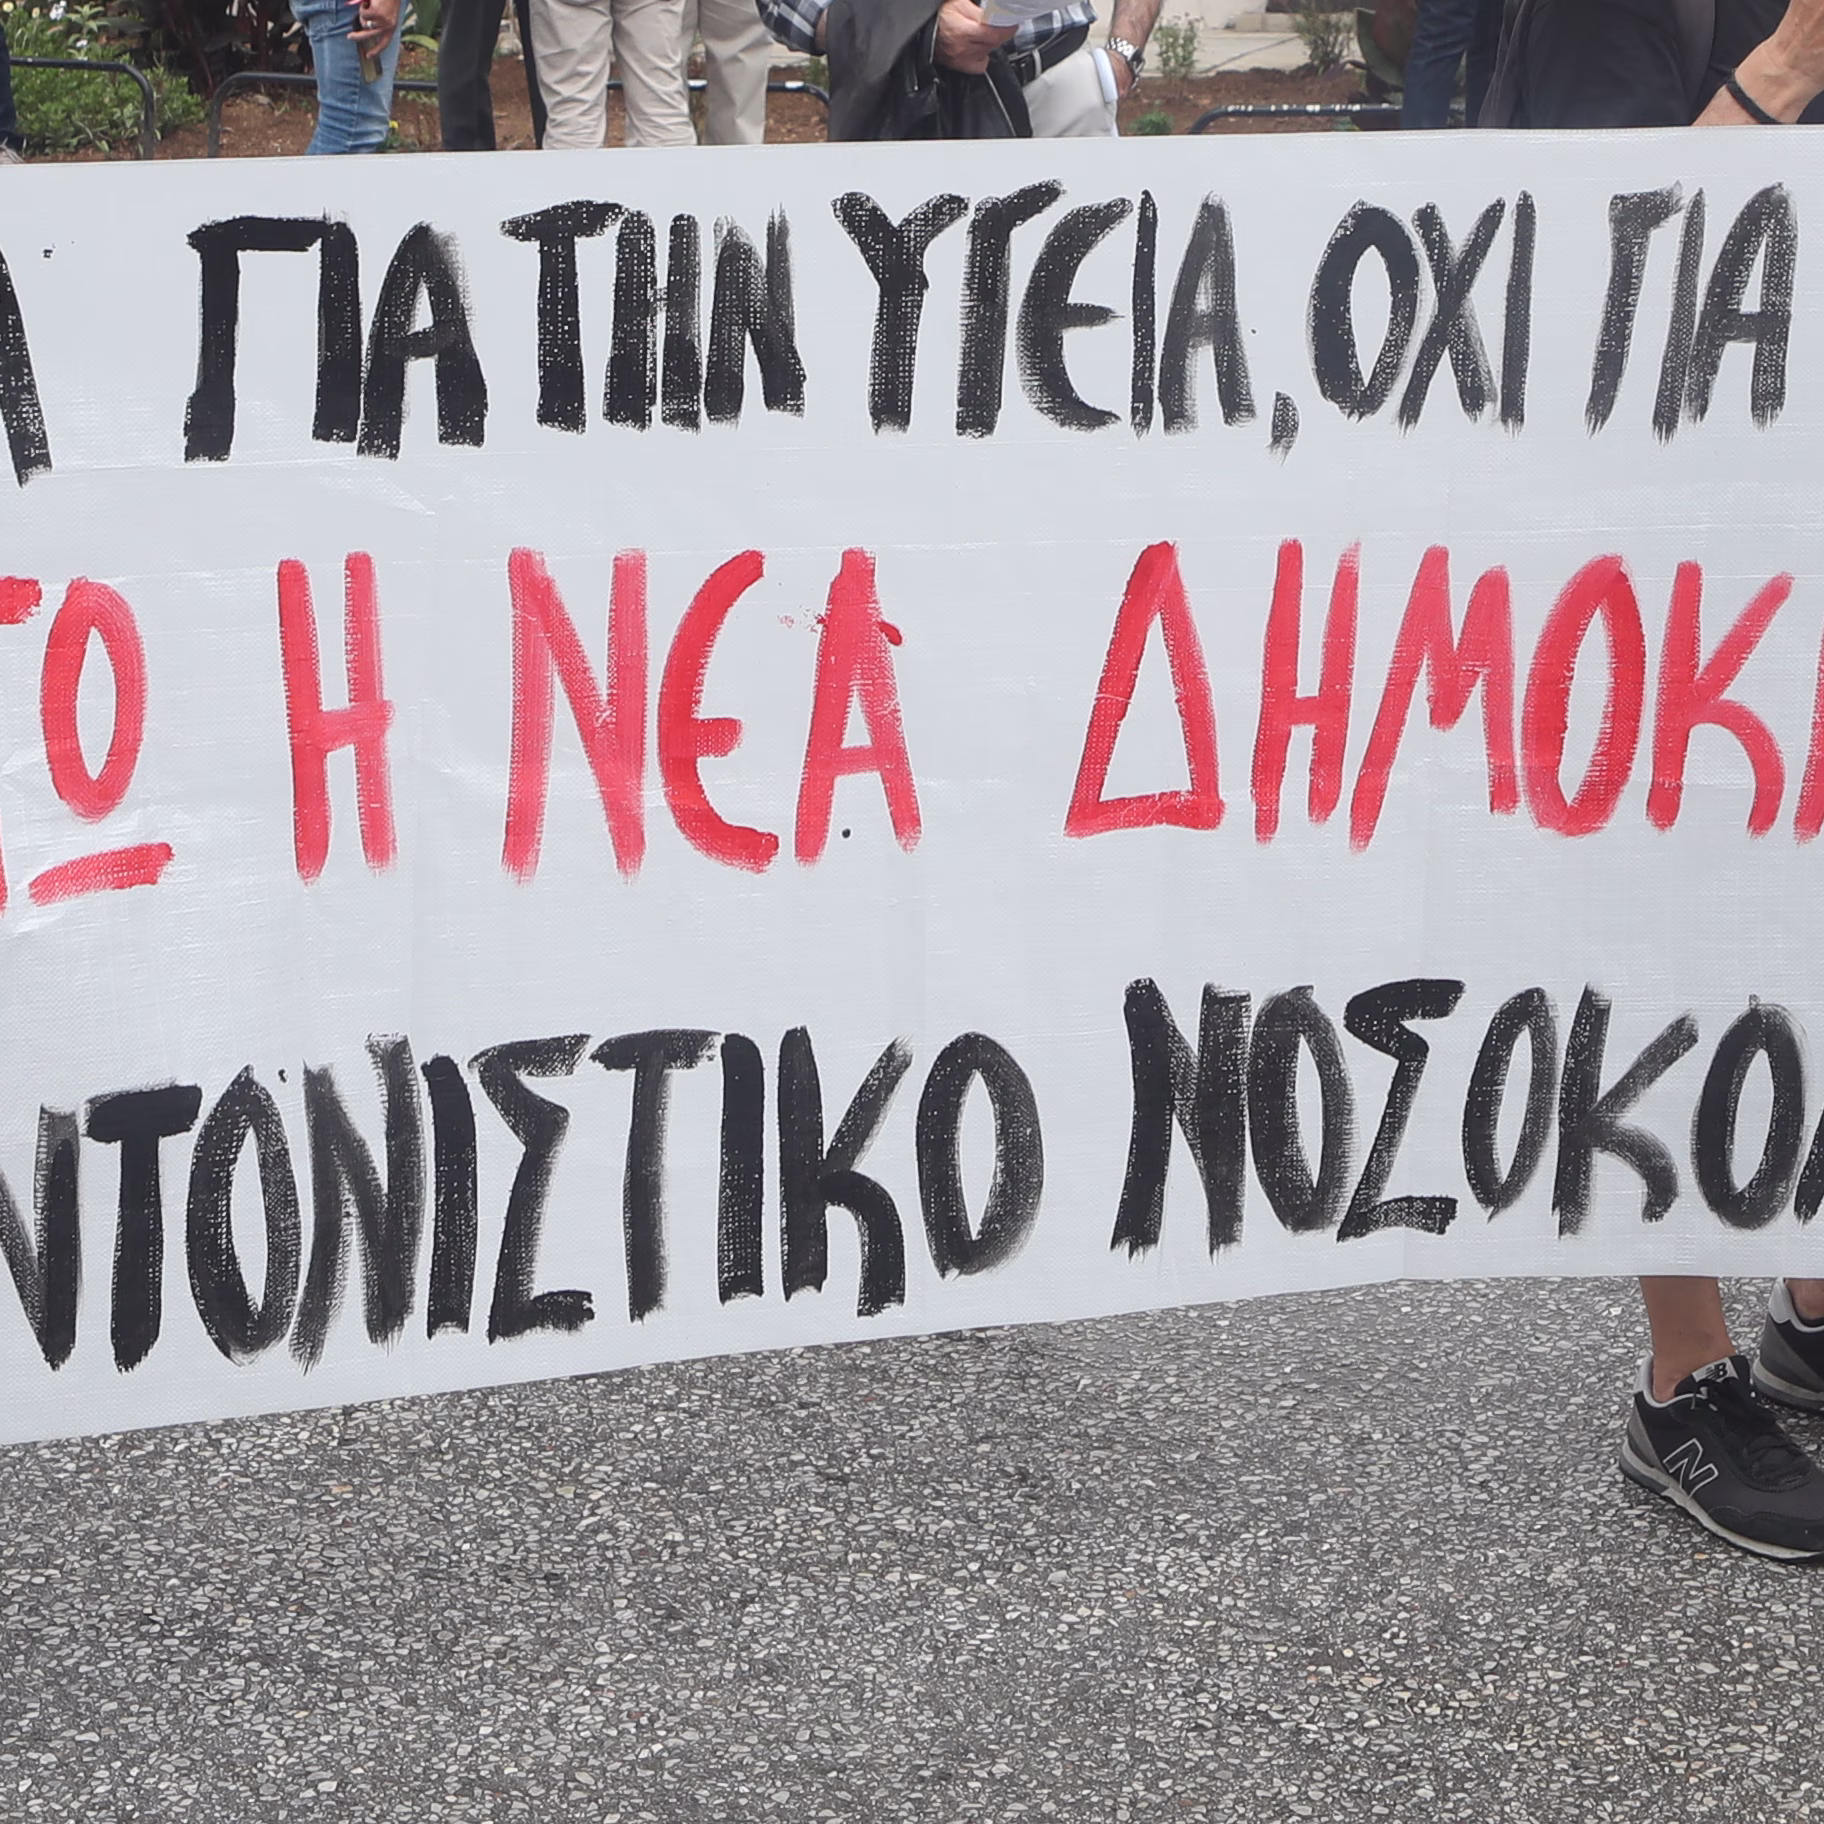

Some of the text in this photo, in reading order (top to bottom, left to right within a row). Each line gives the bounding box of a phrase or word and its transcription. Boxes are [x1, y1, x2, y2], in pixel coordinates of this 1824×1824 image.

[1585, 181, 1799, 444] ΓΙΑ
[276, 550, 396, 884] Η
[500, 546, 924, 884] ΝΕΑ
